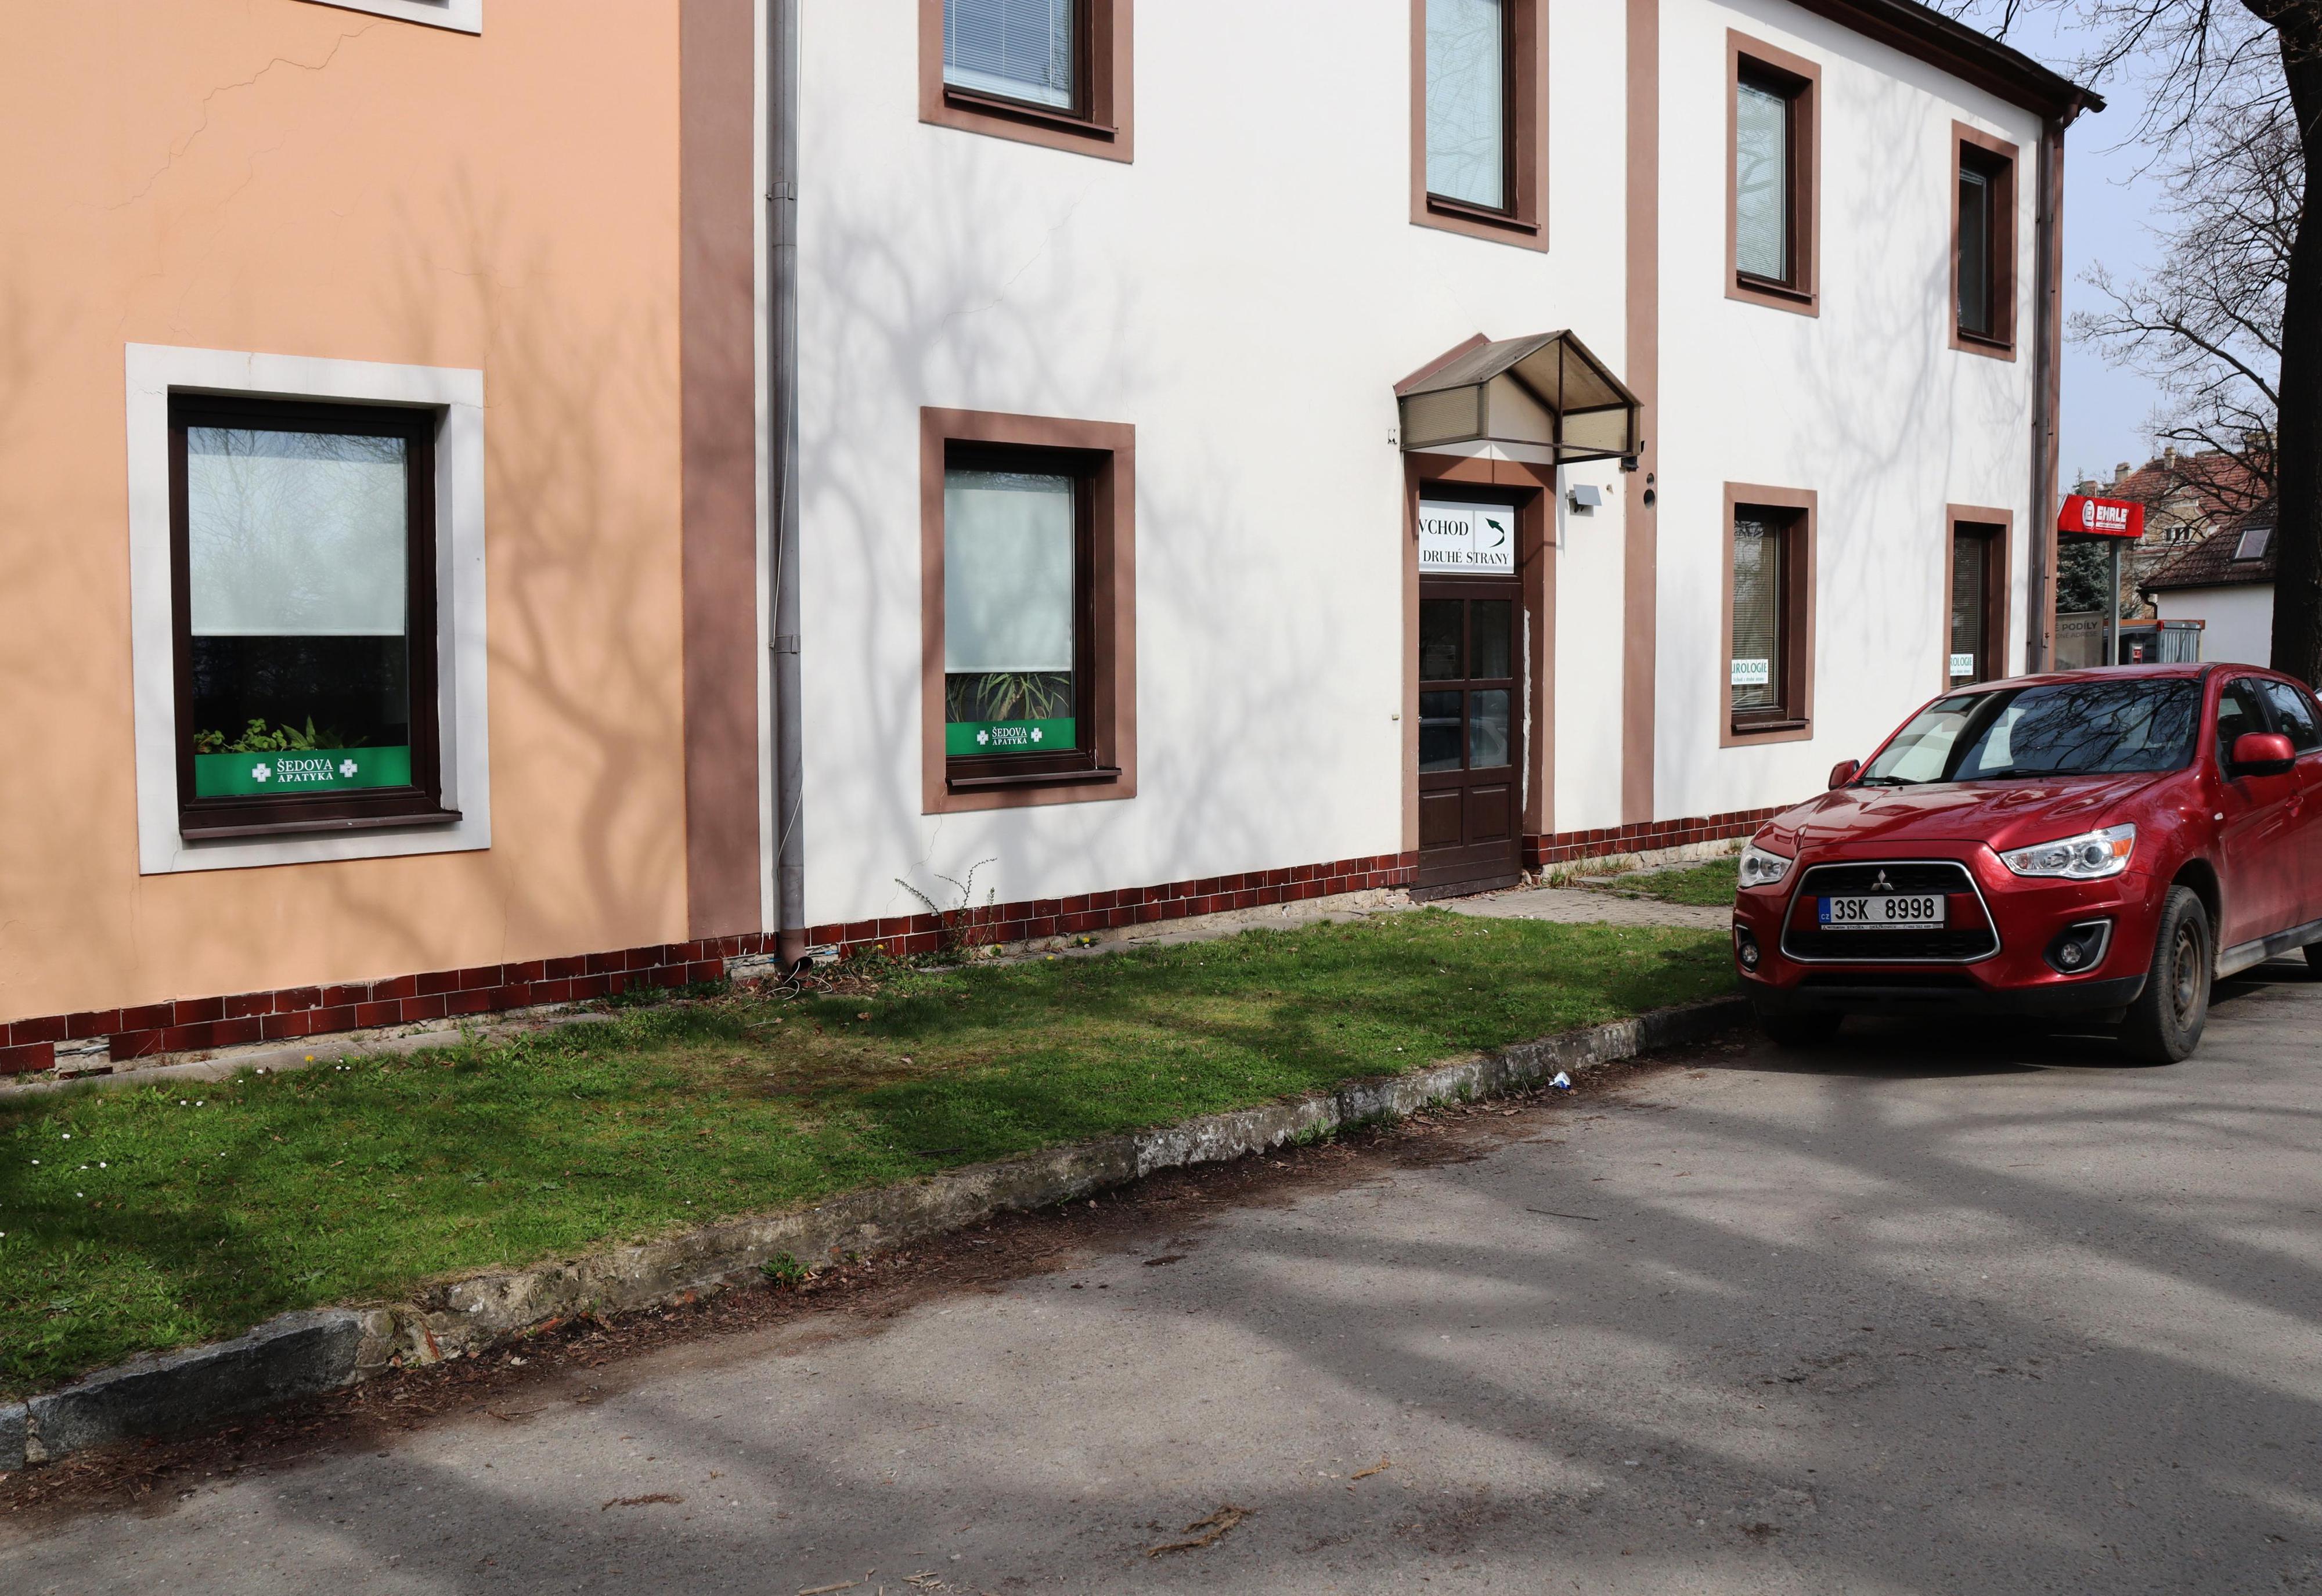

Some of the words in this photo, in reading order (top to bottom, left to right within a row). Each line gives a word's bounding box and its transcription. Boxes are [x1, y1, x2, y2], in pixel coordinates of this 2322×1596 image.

[2096, 505, 2128, 523] EHRLE
[1419, 519, 1469, 536] VCHOD
[1423, 548, 1463, 563] DRUHÉ
[1466, 552, 1509, 565] STRANY
[2062, 620, 2098, 631] PODÍLY
[992, 727, 1027, 737] ŠEDOVA
[992, 738, 1027, 746] APATYKA
[277, 758, 333, 772] ŠEDOVA
[277, 772, 334, 782] APATYKA
[1834, 900, 1870, 920] 3SK
[1885, 898, 1935, 919] 8998
